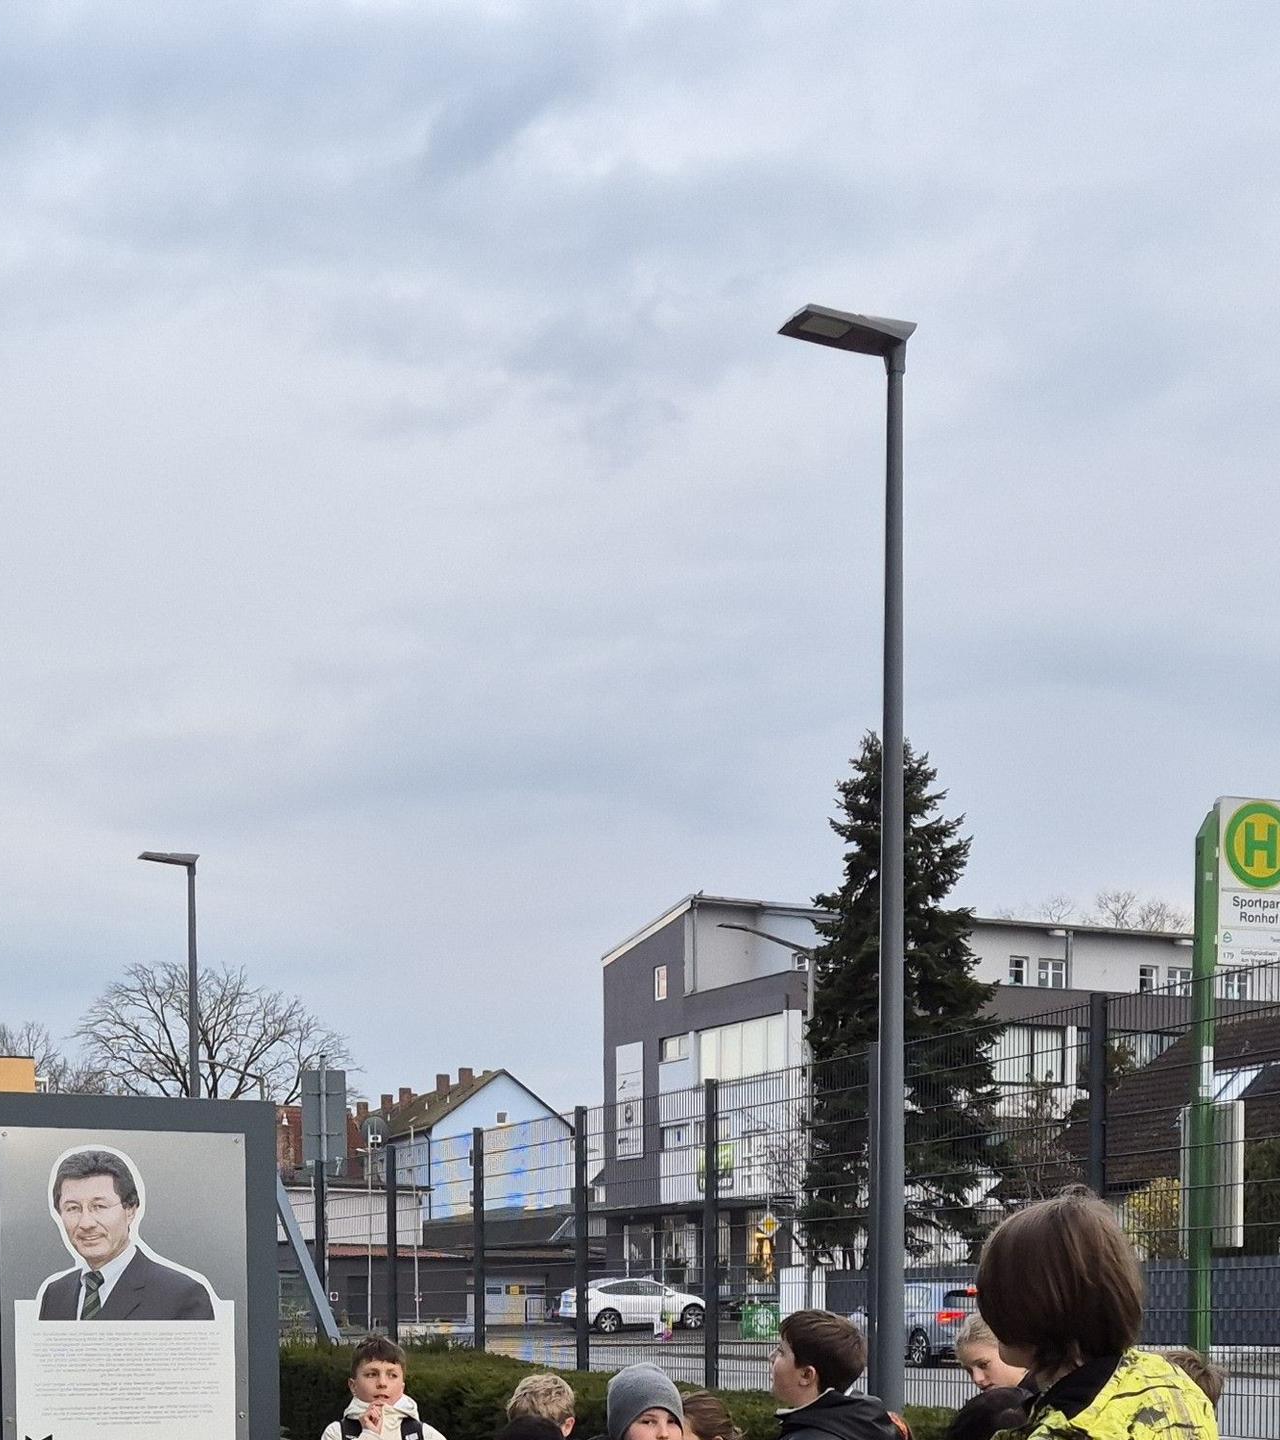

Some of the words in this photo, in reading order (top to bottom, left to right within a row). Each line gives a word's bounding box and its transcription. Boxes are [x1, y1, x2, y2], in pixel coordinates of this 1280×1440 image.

[1243, 821, 1278, 869] H
[1239, 911, 1279, 924] Ronhof
[1223, 952, 1234, 960] 179
